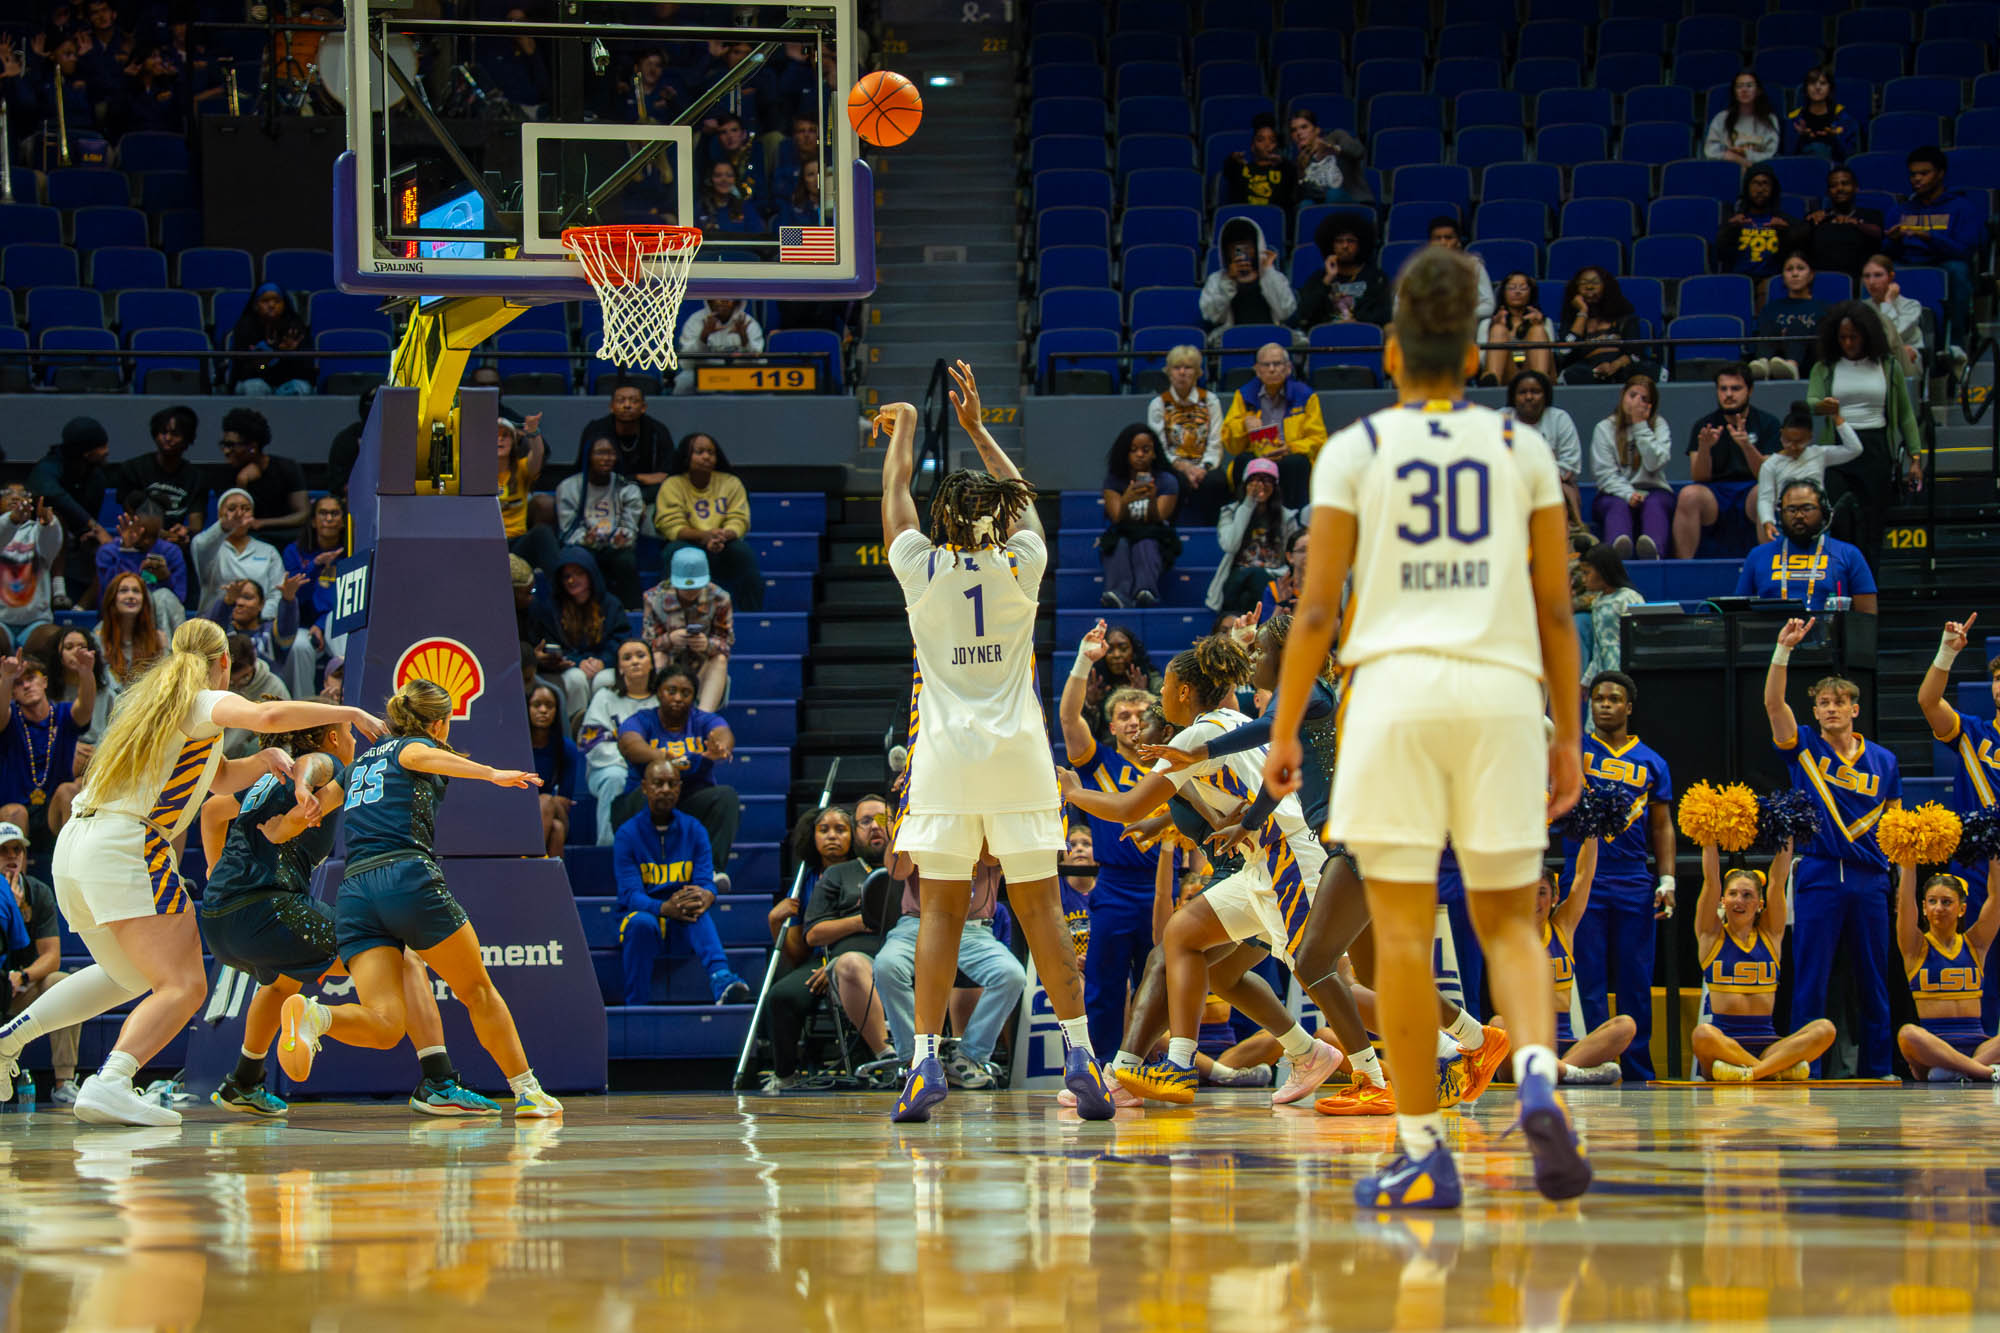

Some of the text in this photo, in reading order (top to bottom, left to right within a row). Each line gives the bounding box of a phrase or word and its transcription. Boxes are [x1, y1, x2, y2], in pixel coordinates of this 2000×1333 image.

[374, 262, 424, 272] SPALDING
[751, 370, 804, 387] 119
[1397, 457, 1490, 545] 30
[1887, 529, 1928, 549] 120
[1771, 554, 1829, 571] LSU
[1401, 560, 1490, 591] RICHARD
[336, 565, 369, 620] YETI
[962, 584, 985, 637] 1
[952, 644, 1003, 665] JOYNER
[649, 736, 705, 757] LSU
[1583, 752, 1648, 788] LSU
[1819, 756, 1880, 797] LSU
[343, 758, 388, 812] 25
[1712, 960, 1777, 985] LSU
[1919, 967, 1982, 992] LSU
